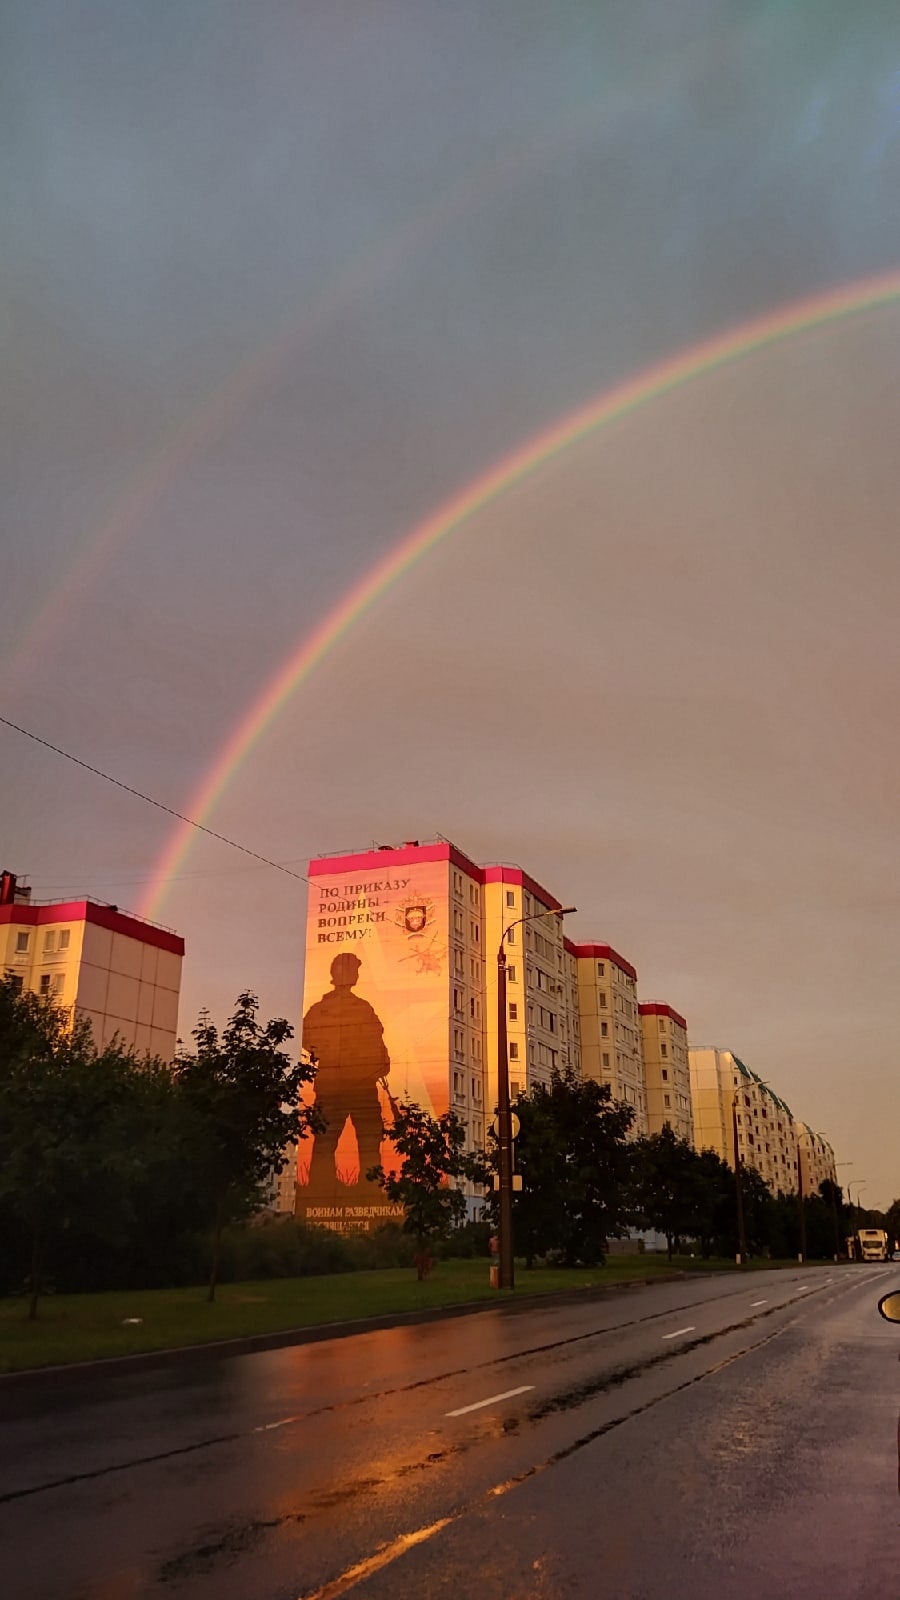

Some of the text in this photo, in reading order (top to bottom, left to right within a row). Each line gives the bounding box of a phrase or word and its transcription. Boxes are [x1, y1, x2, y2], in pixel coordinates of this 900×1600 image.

[320, 879, 411, 898] ПО ПРИКАЗУ
[319, 897, 379, 913] РОДИНЫ
[317, 911, 386, 928] ВОПРЕКИ
[306, 1205, 404, 1218] ВОИНАМ РАЗВЕДЧИКАМ
